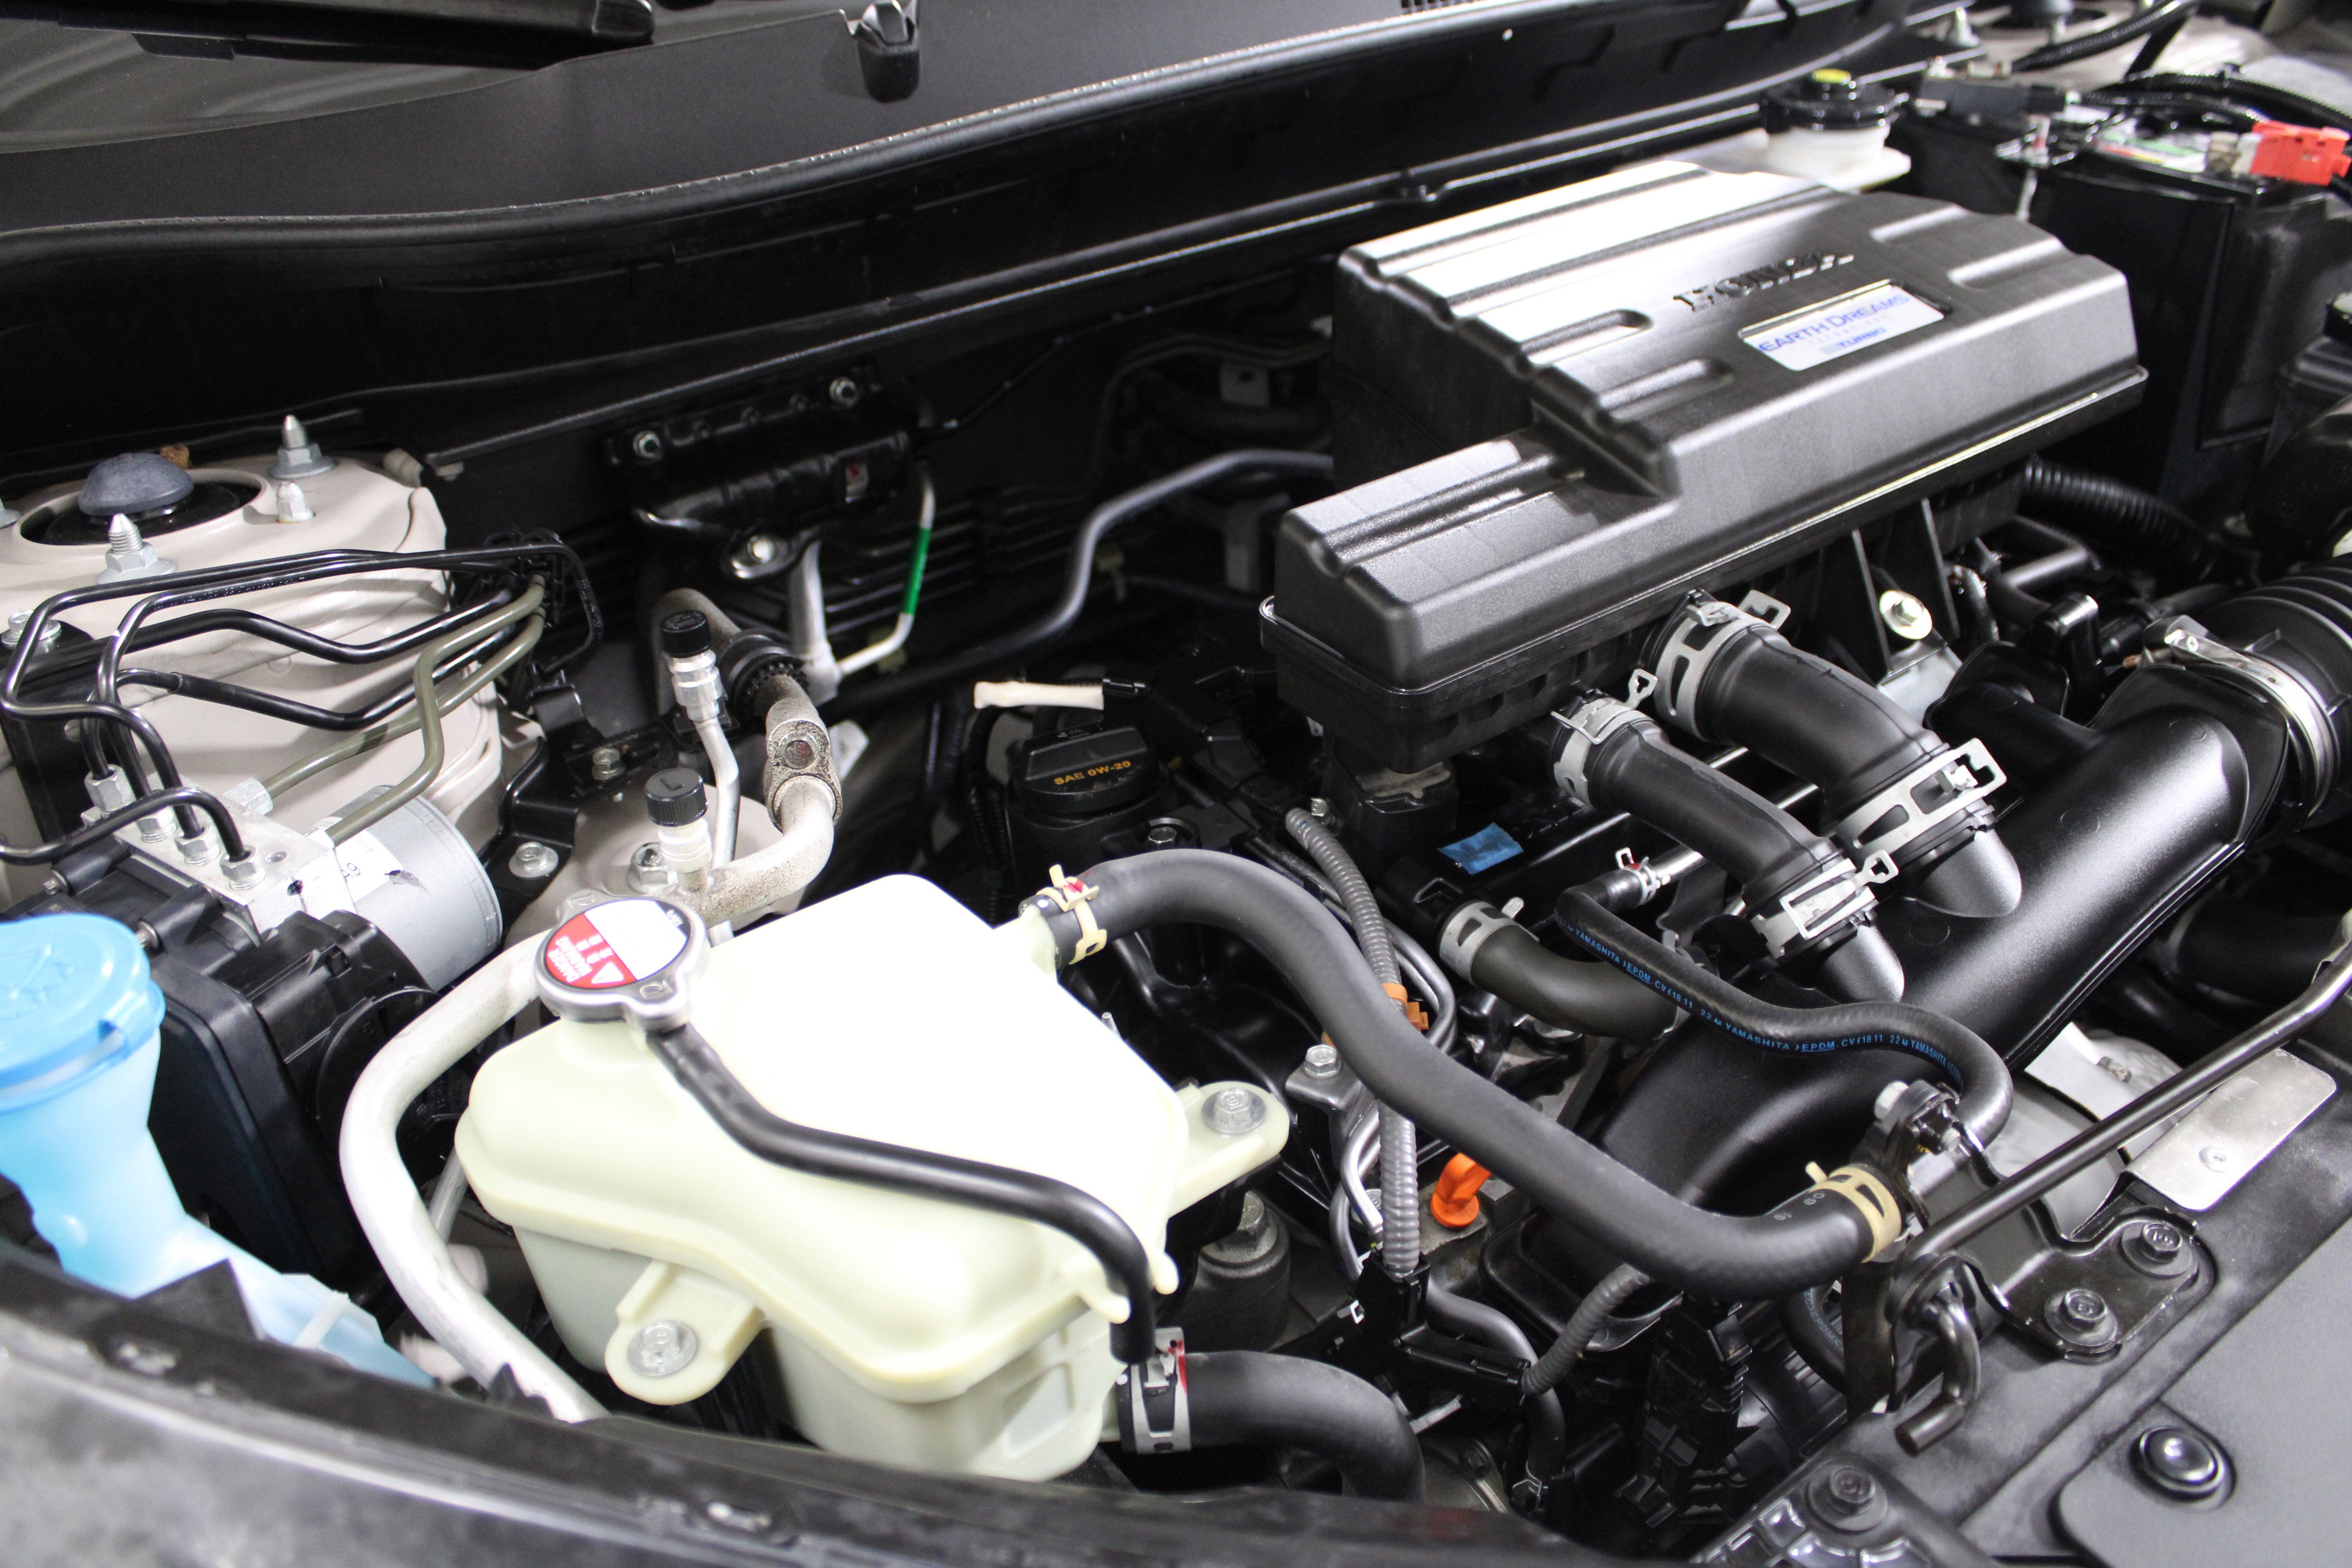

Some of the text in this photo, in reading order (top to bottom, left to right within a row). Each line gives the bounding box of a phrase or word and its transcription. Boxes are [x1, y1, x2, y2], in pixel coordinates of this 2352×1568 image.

[1758, 322, 1830, 352] EARTH
[1837, 326, 1886, 348] TURBO
[1054, 760, 1132, 785] SAE 0W-20
[1575, 928, 1620, 964] YAMASHITA
[1726, 1022, 1790, 1050] YAMASHITA
[1911, 1038, 1947, 1067] YAMASHITA
